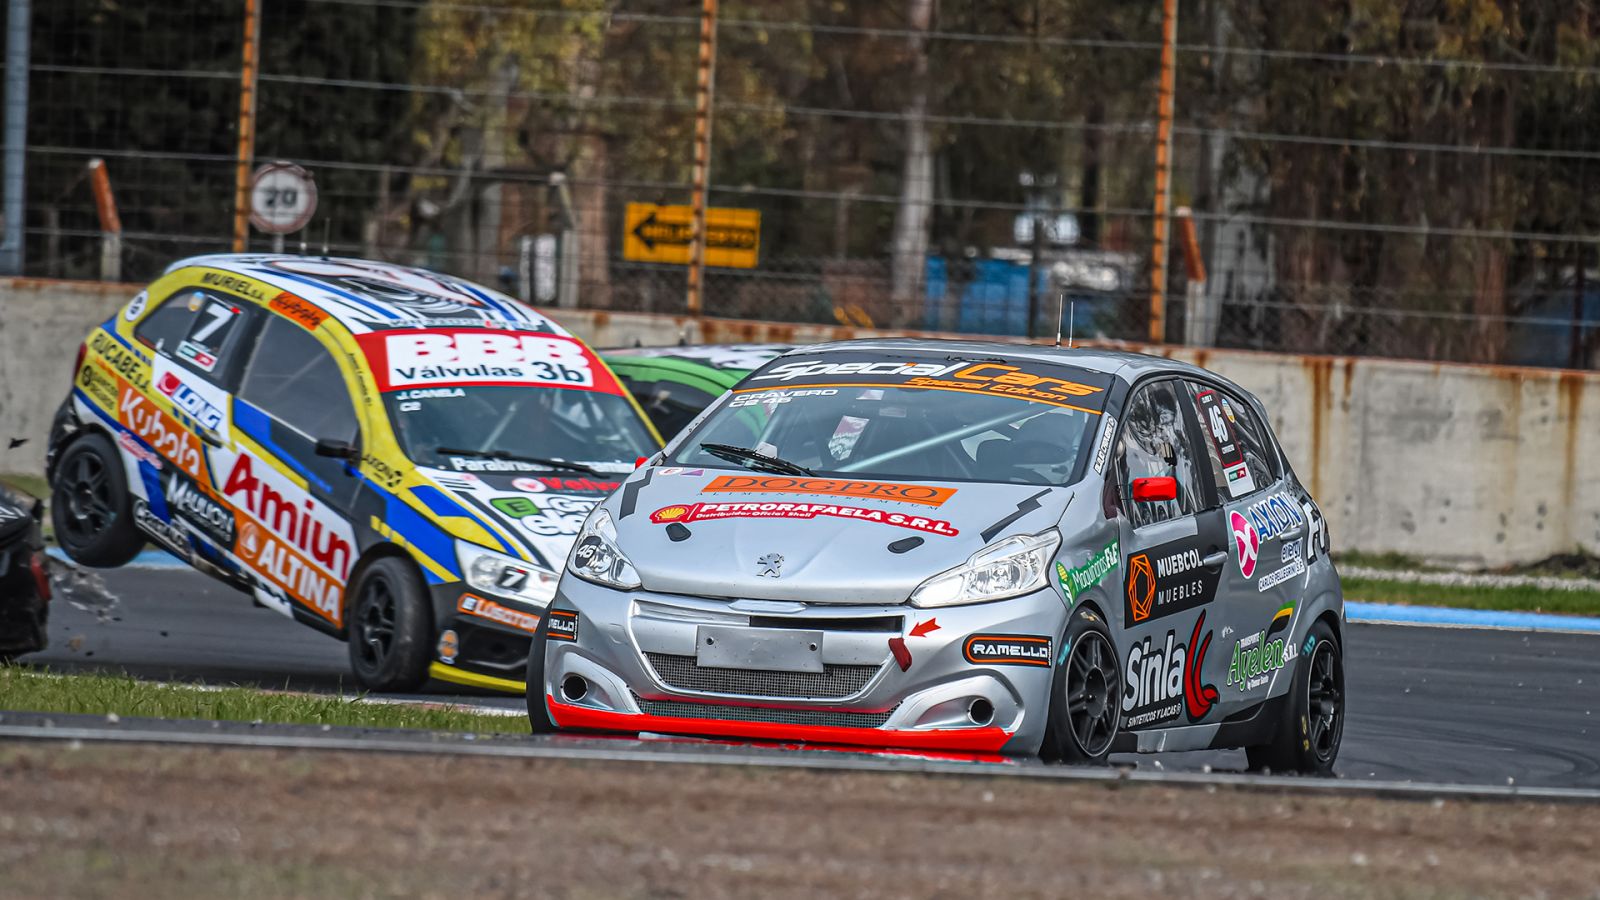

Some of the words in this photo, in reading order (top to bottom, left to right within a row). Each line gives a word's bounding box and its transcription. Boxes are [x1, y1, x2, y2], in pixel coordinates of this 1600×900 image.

[262, 187, 297, 208] 20
[191, 303, 234, 342] 7
[386, 334, 589, 369] BBB
[396, 364, 523, 380] Válvulas
[532, 361, 585, 383] 3b
[751, 360, 970, 381] Special
[954, 363, 1104, 396] Cars
[734, 389, 838, 401] CRAVERO
[904, 377, 990, 389] Special
[989, 384, 1068, 400] Edition
[121, 388, 200, 476] Kubota
[1208, 405, 1229, 443] 46
[723, 477, 938, 499] DOGPRO
[224, 453, 350, 580] Amiun
[700, 503, 882, 520] PETRORAFAELA
[887, 514, 954, 534] S.R.L.
[1248, 493, 1302, 543] AXION
[577, 544, 597, 558] 46
[1157, 548, 1203, 578] MUEBCOL
[258, 539, 339, 620] ALTINA
[501, 570, 526, 587] 7
[1158, 580, 1203, 605] MUEBLES
[973, 644, 1048, 658] RAMELLO
[1227, 630, 1284, 691] Ayelen
[1122, 634, 1186, 711] Sinla
[1128, 710, 1157, 727] SINTETICOS
